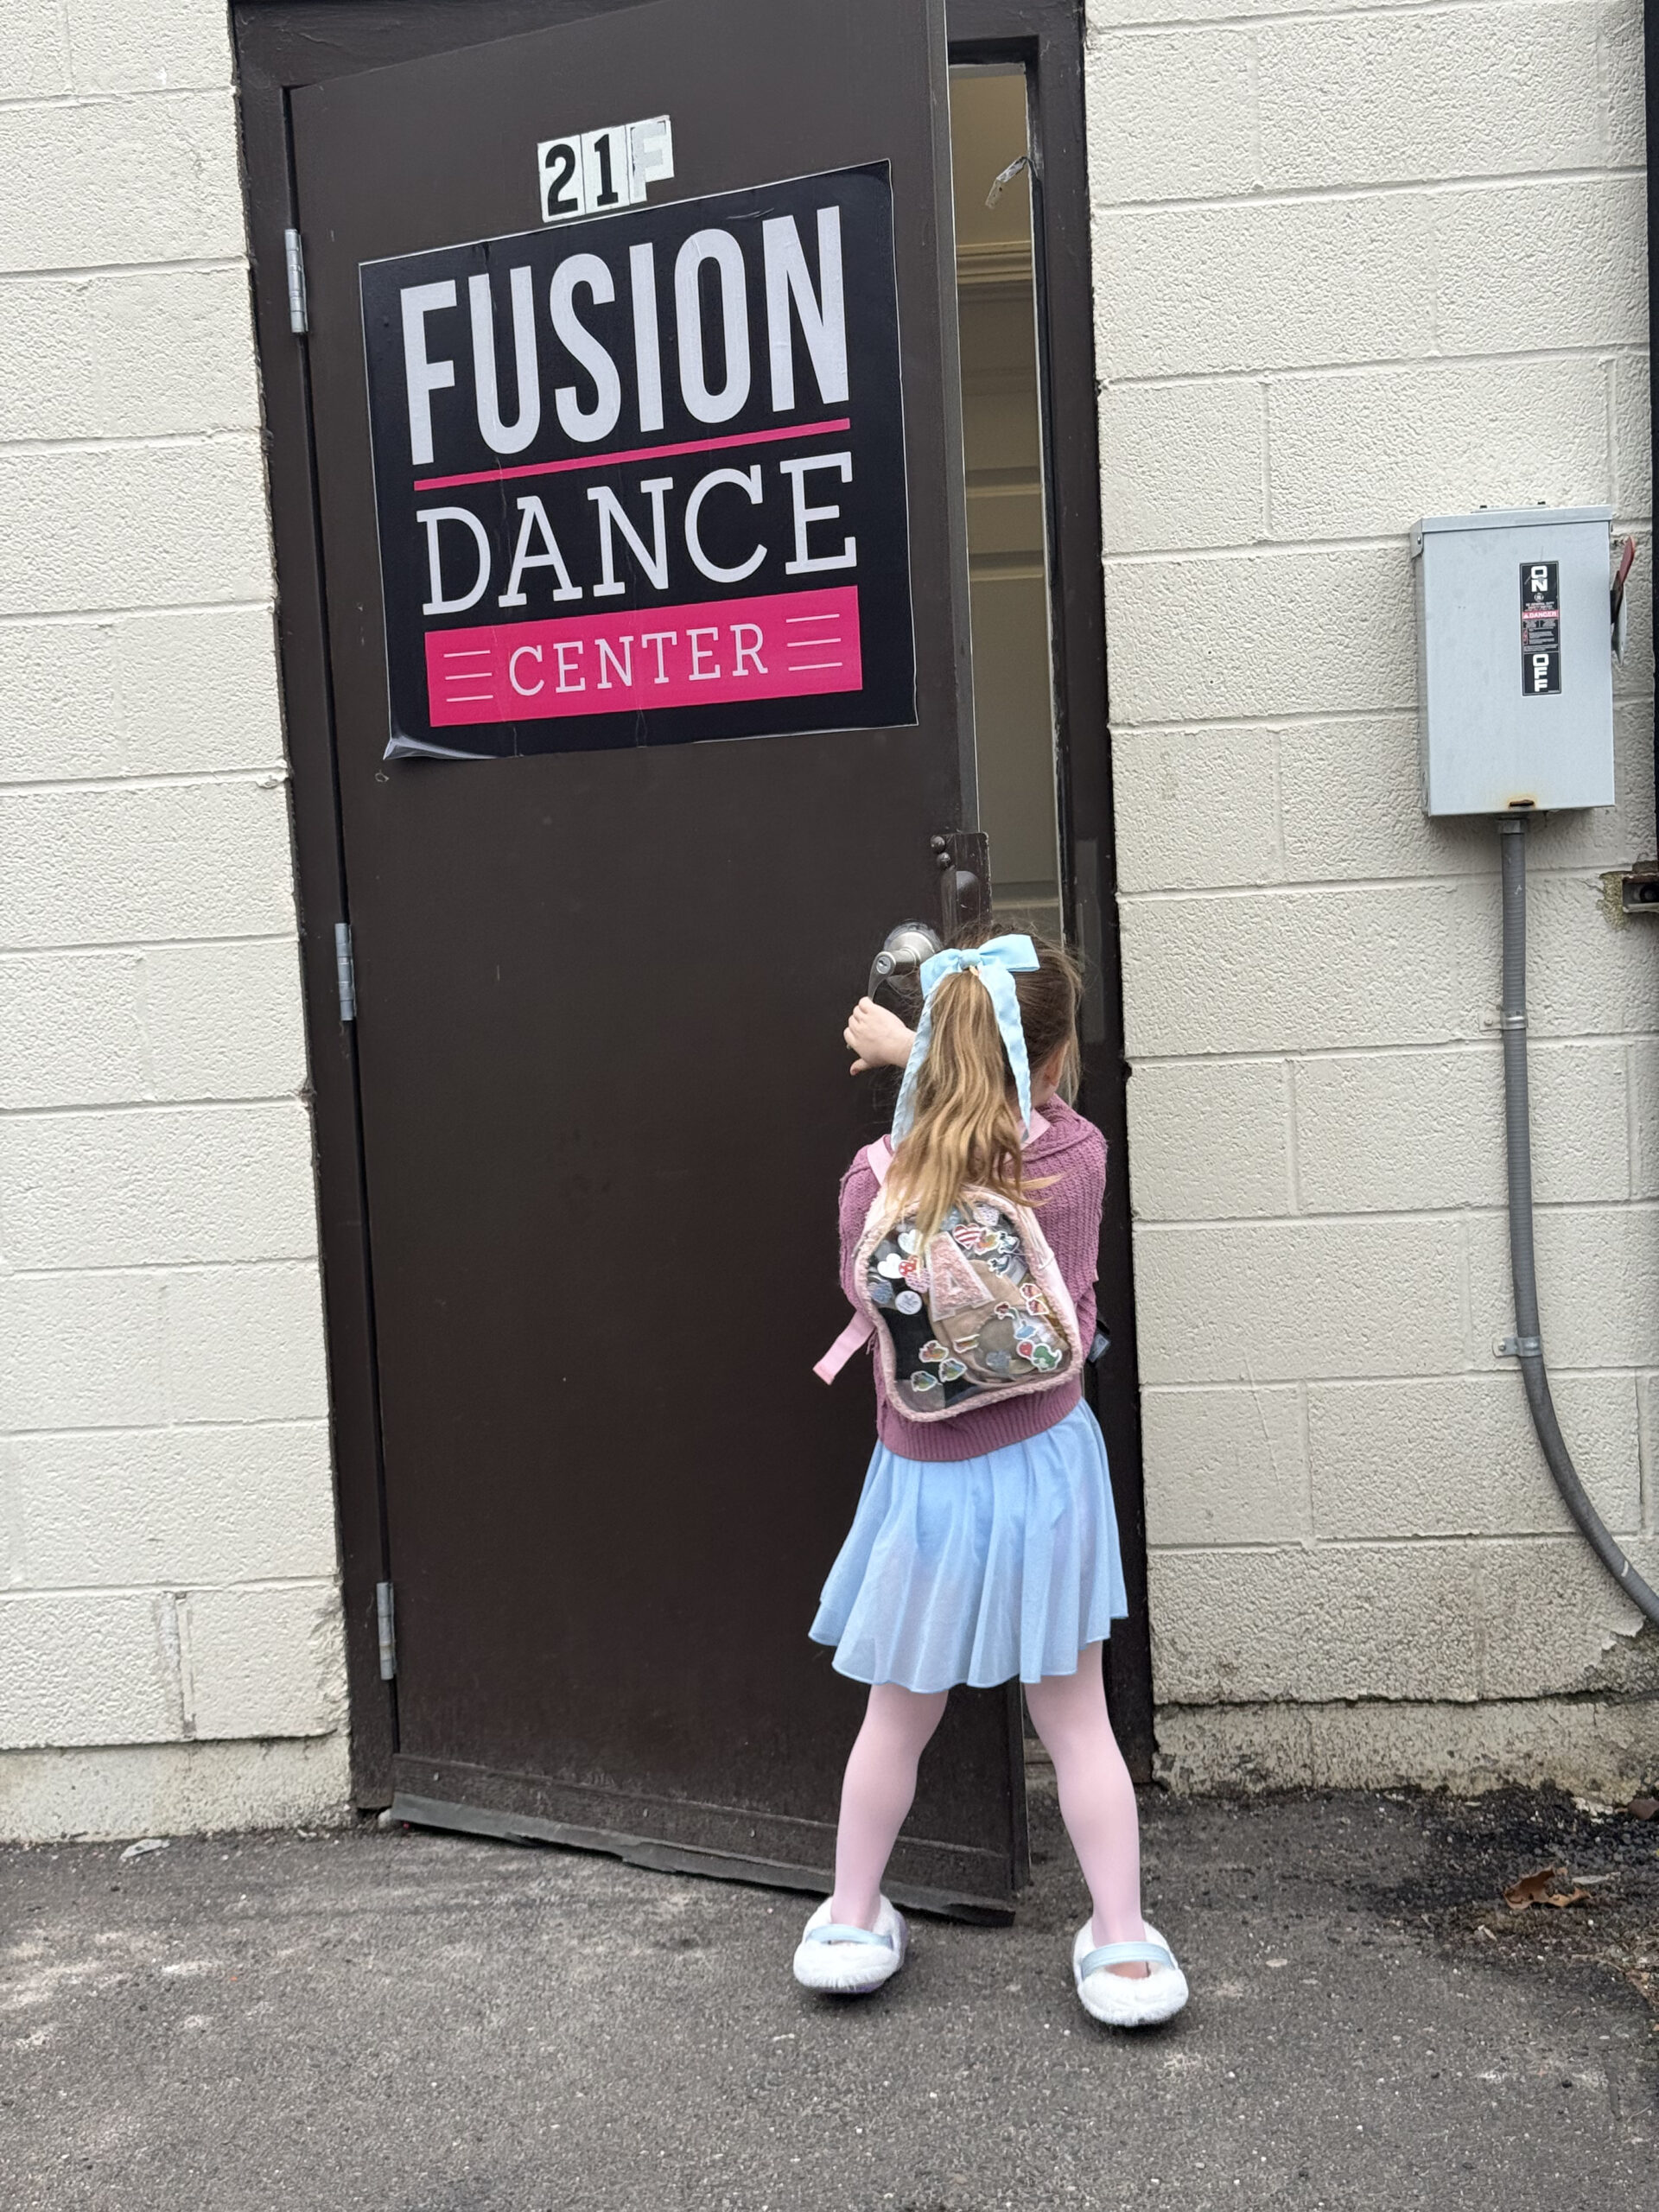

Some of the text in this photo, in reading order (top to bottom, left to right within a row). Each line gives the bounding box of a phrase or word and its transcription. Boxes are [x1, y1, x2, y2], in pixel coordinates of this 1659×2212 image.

[400, 206, 849, 465] FUSION
[416, 451, 857, 615] DANCE
[1530, 565, 1548, 593] ON
[1529, 610, 1557, 619] DANGER
[508, 622, 769, 696] CENTER
[1532, 653, 1549, 692] OFF
